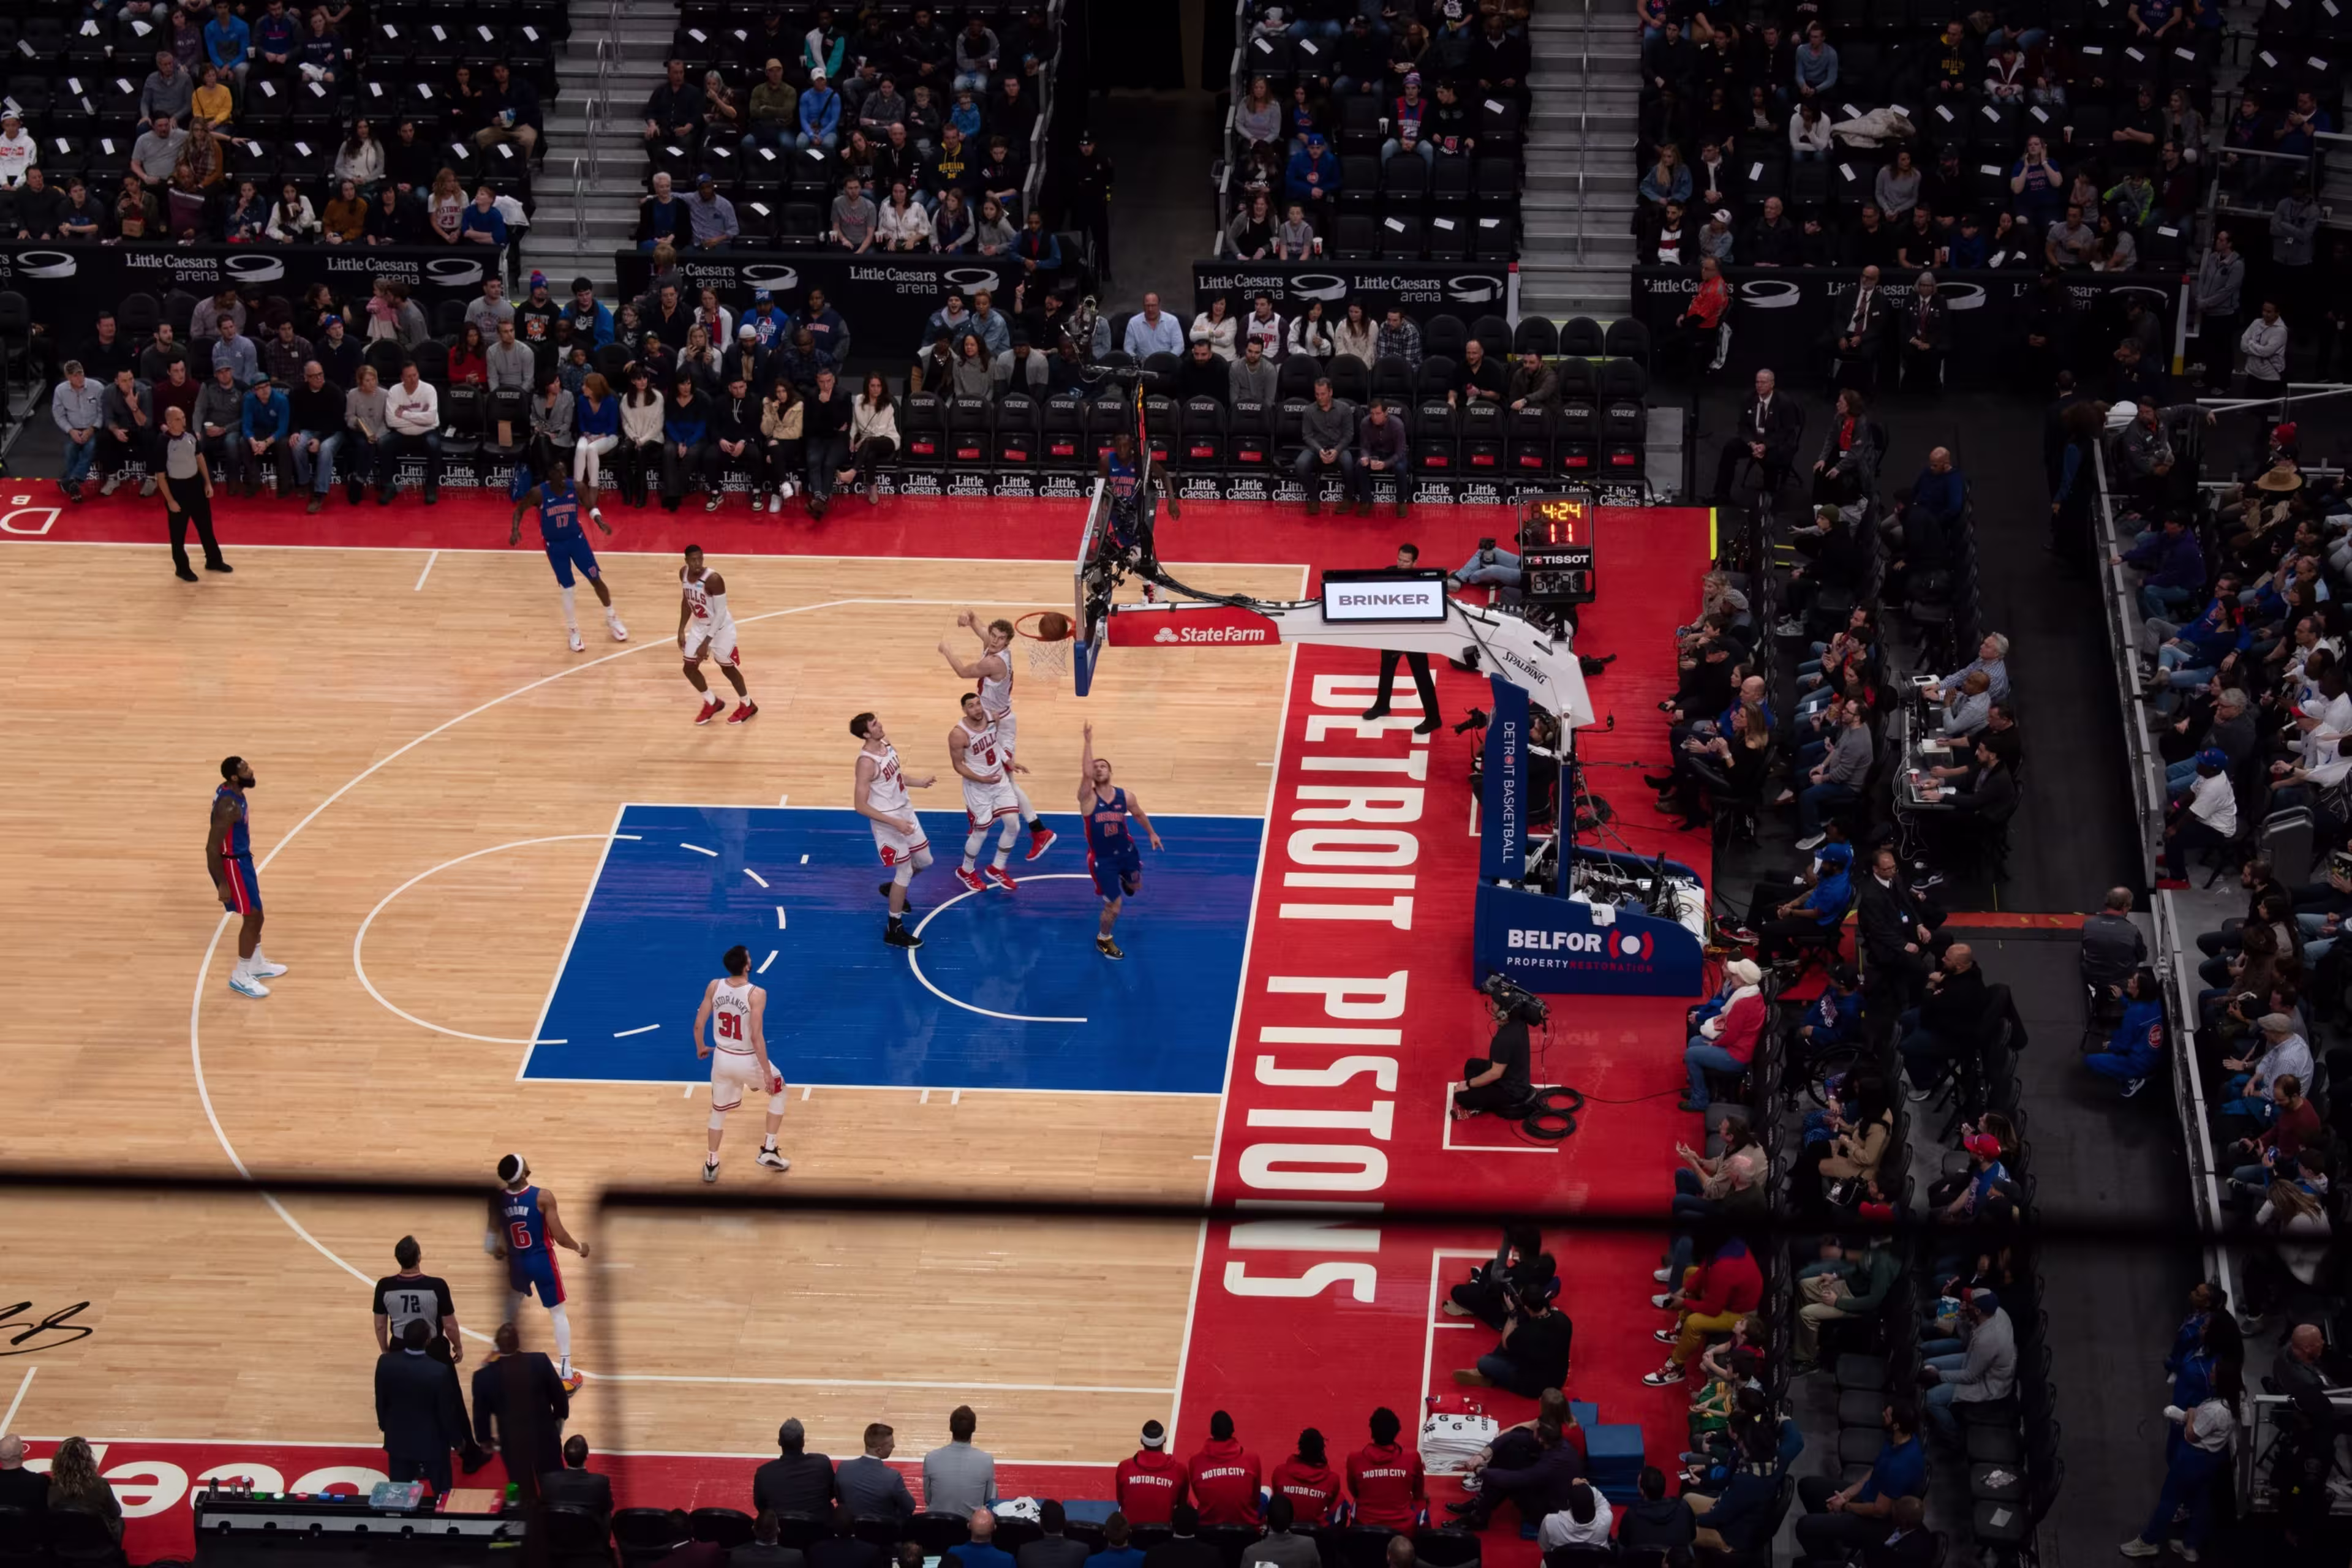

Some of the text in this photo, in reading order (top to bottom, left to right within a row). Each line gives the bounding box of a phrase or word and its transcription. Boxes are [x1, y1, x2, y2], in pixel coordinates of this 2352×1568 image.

[126, 253, 217, 268] Little Caesars
[326, 257, 419, 272] Little Caesars
[685, 263, 735, 276] Caesars
[849, 266, 937, 282] Little Caesars
[175, 270, 220, 282] arena
[1199, 274, 1284, 290] Little Caesars
[696, 278, 736, 289] arena
[896, 282, 938, 294] arena
[1354, 276, 1441, 290] Little Caesars
[1400, 291, 1441, 303] arena
[446, 466, 475, 478] Little
[439, 476, 479, 487] Caesars
[909, 474, 937, 486] Little
[956, 475, 984, 486] Little
[1001, 478, 1030, 489] Little
[1048, 478, 1076, 489] Little
[1188, 478, 1215, 489] Little
[1235, 479, 1262, 490] Little
[901, 484, 941, 495] Caesars
[947, 484, 987, 496] Caesars
[993, 487, 1034, 497] Caesars
[1039, 487, 1080, 497] Caesars
[1180, 488, 1220, 499] Caesars
[1226, 488, 1267, 500] Caesars
[1422, 483, 1450, 494] Little
[1468, 483, 1496, 494] Little
[1608, 485, 1636, 498] Little
[1319, 490, 1343, 502] Caes
[1412, 492, 1453, 504] Caesars
[1460, 492, 1500, 504] Caesars
[1599, 495, 1640, 507] Caesars
[1542, 502, 1581, 521] 4:24
[1550, 522, 1574, 543] 11
[1542, 554, 1589, 565] TISSOT
[1338, 593, 1430, 606] BRINKER
[1502, 651, 1547, 685] SPALDING
[986, 748, 997, 767] 8
[1279, 669, 1436, 930] DETROIT
[1503, 780, 1516, 864] BASKETBALL
[1507, 929, 1602, 952] BELFOR
[1507, 957, 1654, 973] PROPERTY RESTORATION
[714, 995, 750, 1015] SATORANSKY
[718, 1011, 742, 1041] 31
[1224, 970, 1408, 1303] PISTONS
[510, 1221, 532, 1250] 6
[401, 1295, 421, 1313] 72
[1452, 1422, 1463, 1431] G
[1201, 1467, 1245, 1480] MOTOR CITY
[1362, 1468, 1406, 1479] MOTOR CITY
[1128, 1475, 1173, 1488] MOTOR CITY
[1283, 1485, 1326, 1499] MOTOR CITY
